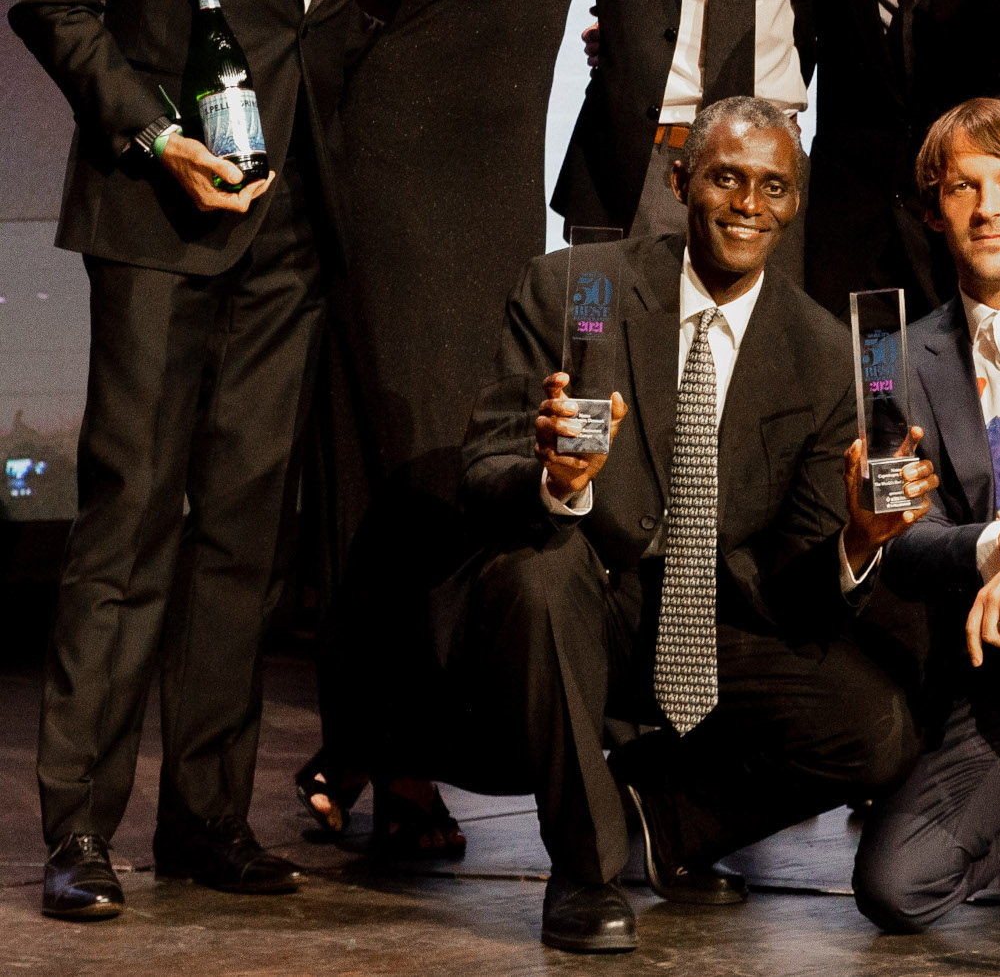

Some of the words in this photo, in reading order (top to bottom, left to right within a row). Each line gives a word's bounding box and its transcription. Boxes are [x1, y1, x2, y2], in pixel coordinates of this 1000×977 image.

[573, 277, 613, 306] 50
[577, 321, 604, 333] 2021
[862, 337, 897, 366] 50
[870, 379, 893, 393] 2021
